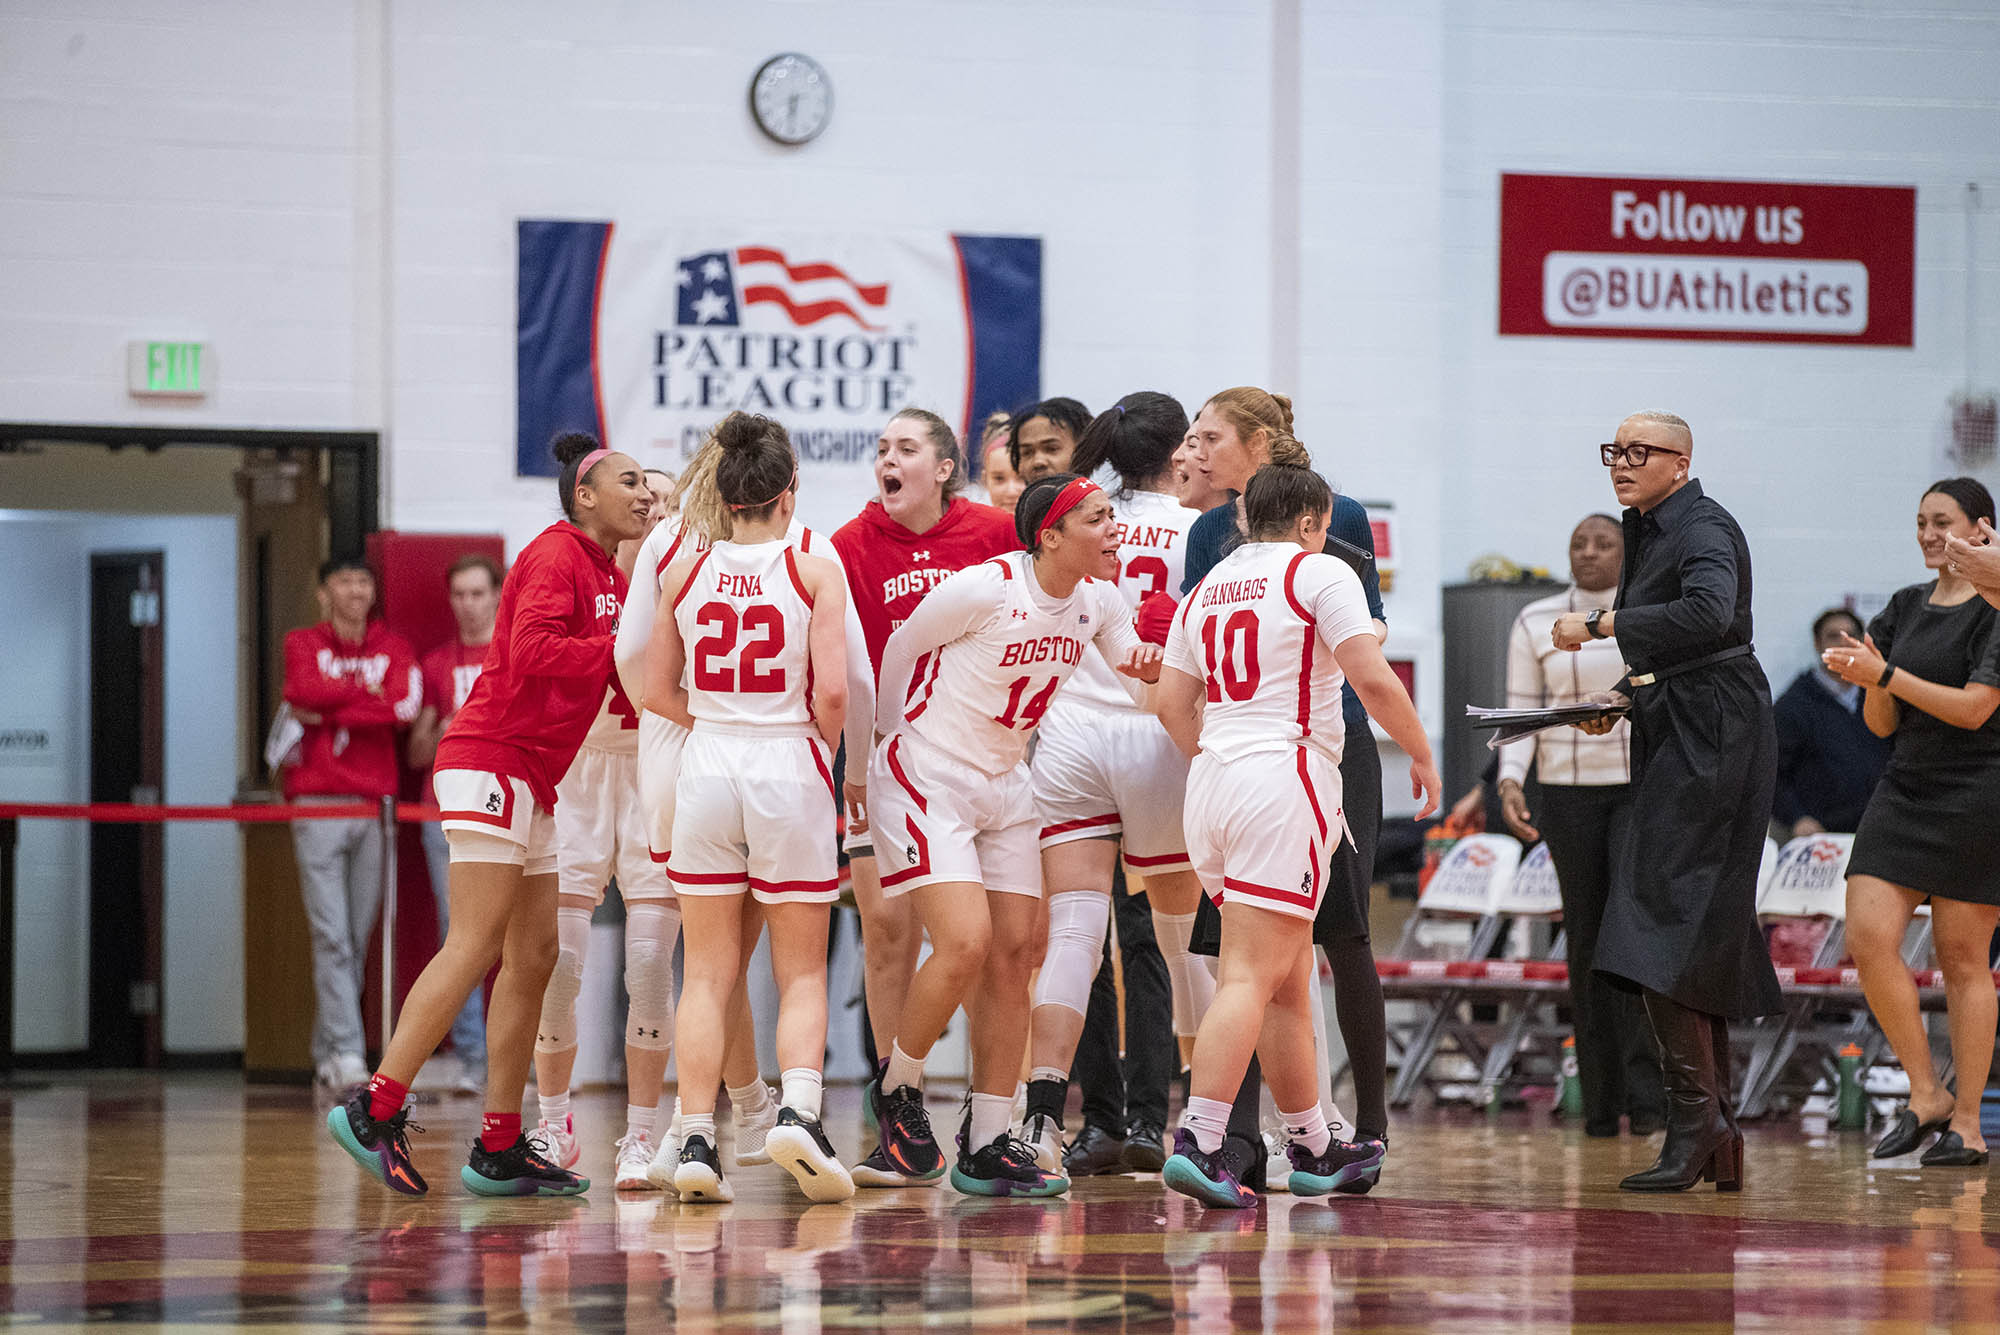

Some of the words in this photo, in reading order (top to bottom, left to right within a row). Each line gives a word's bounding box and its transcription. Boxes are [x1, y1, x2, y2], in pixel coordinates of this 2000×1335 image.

[1610, 190, 1746, 241] Follow
[1755, 206, 1803, 244] us
[1561, 267, 1853, 317] @BUAthletics
[147, 342, 202, 391] EXIT
[653, 332, 917, 371] PATRIOT
[653, 373, 913, 411] LEAGUE
[1116, 523, 1179, 549] RANT
[717, 572, 763, 597] PINA
[1202, 578, 1268, 608] GIANNAROS
[694, 601, 786, 693] 22
[998, 636, 1085, 667] BOSTON
[1201, 609, 1261, 703] 10
[993, 676, 1060, 731] 14
